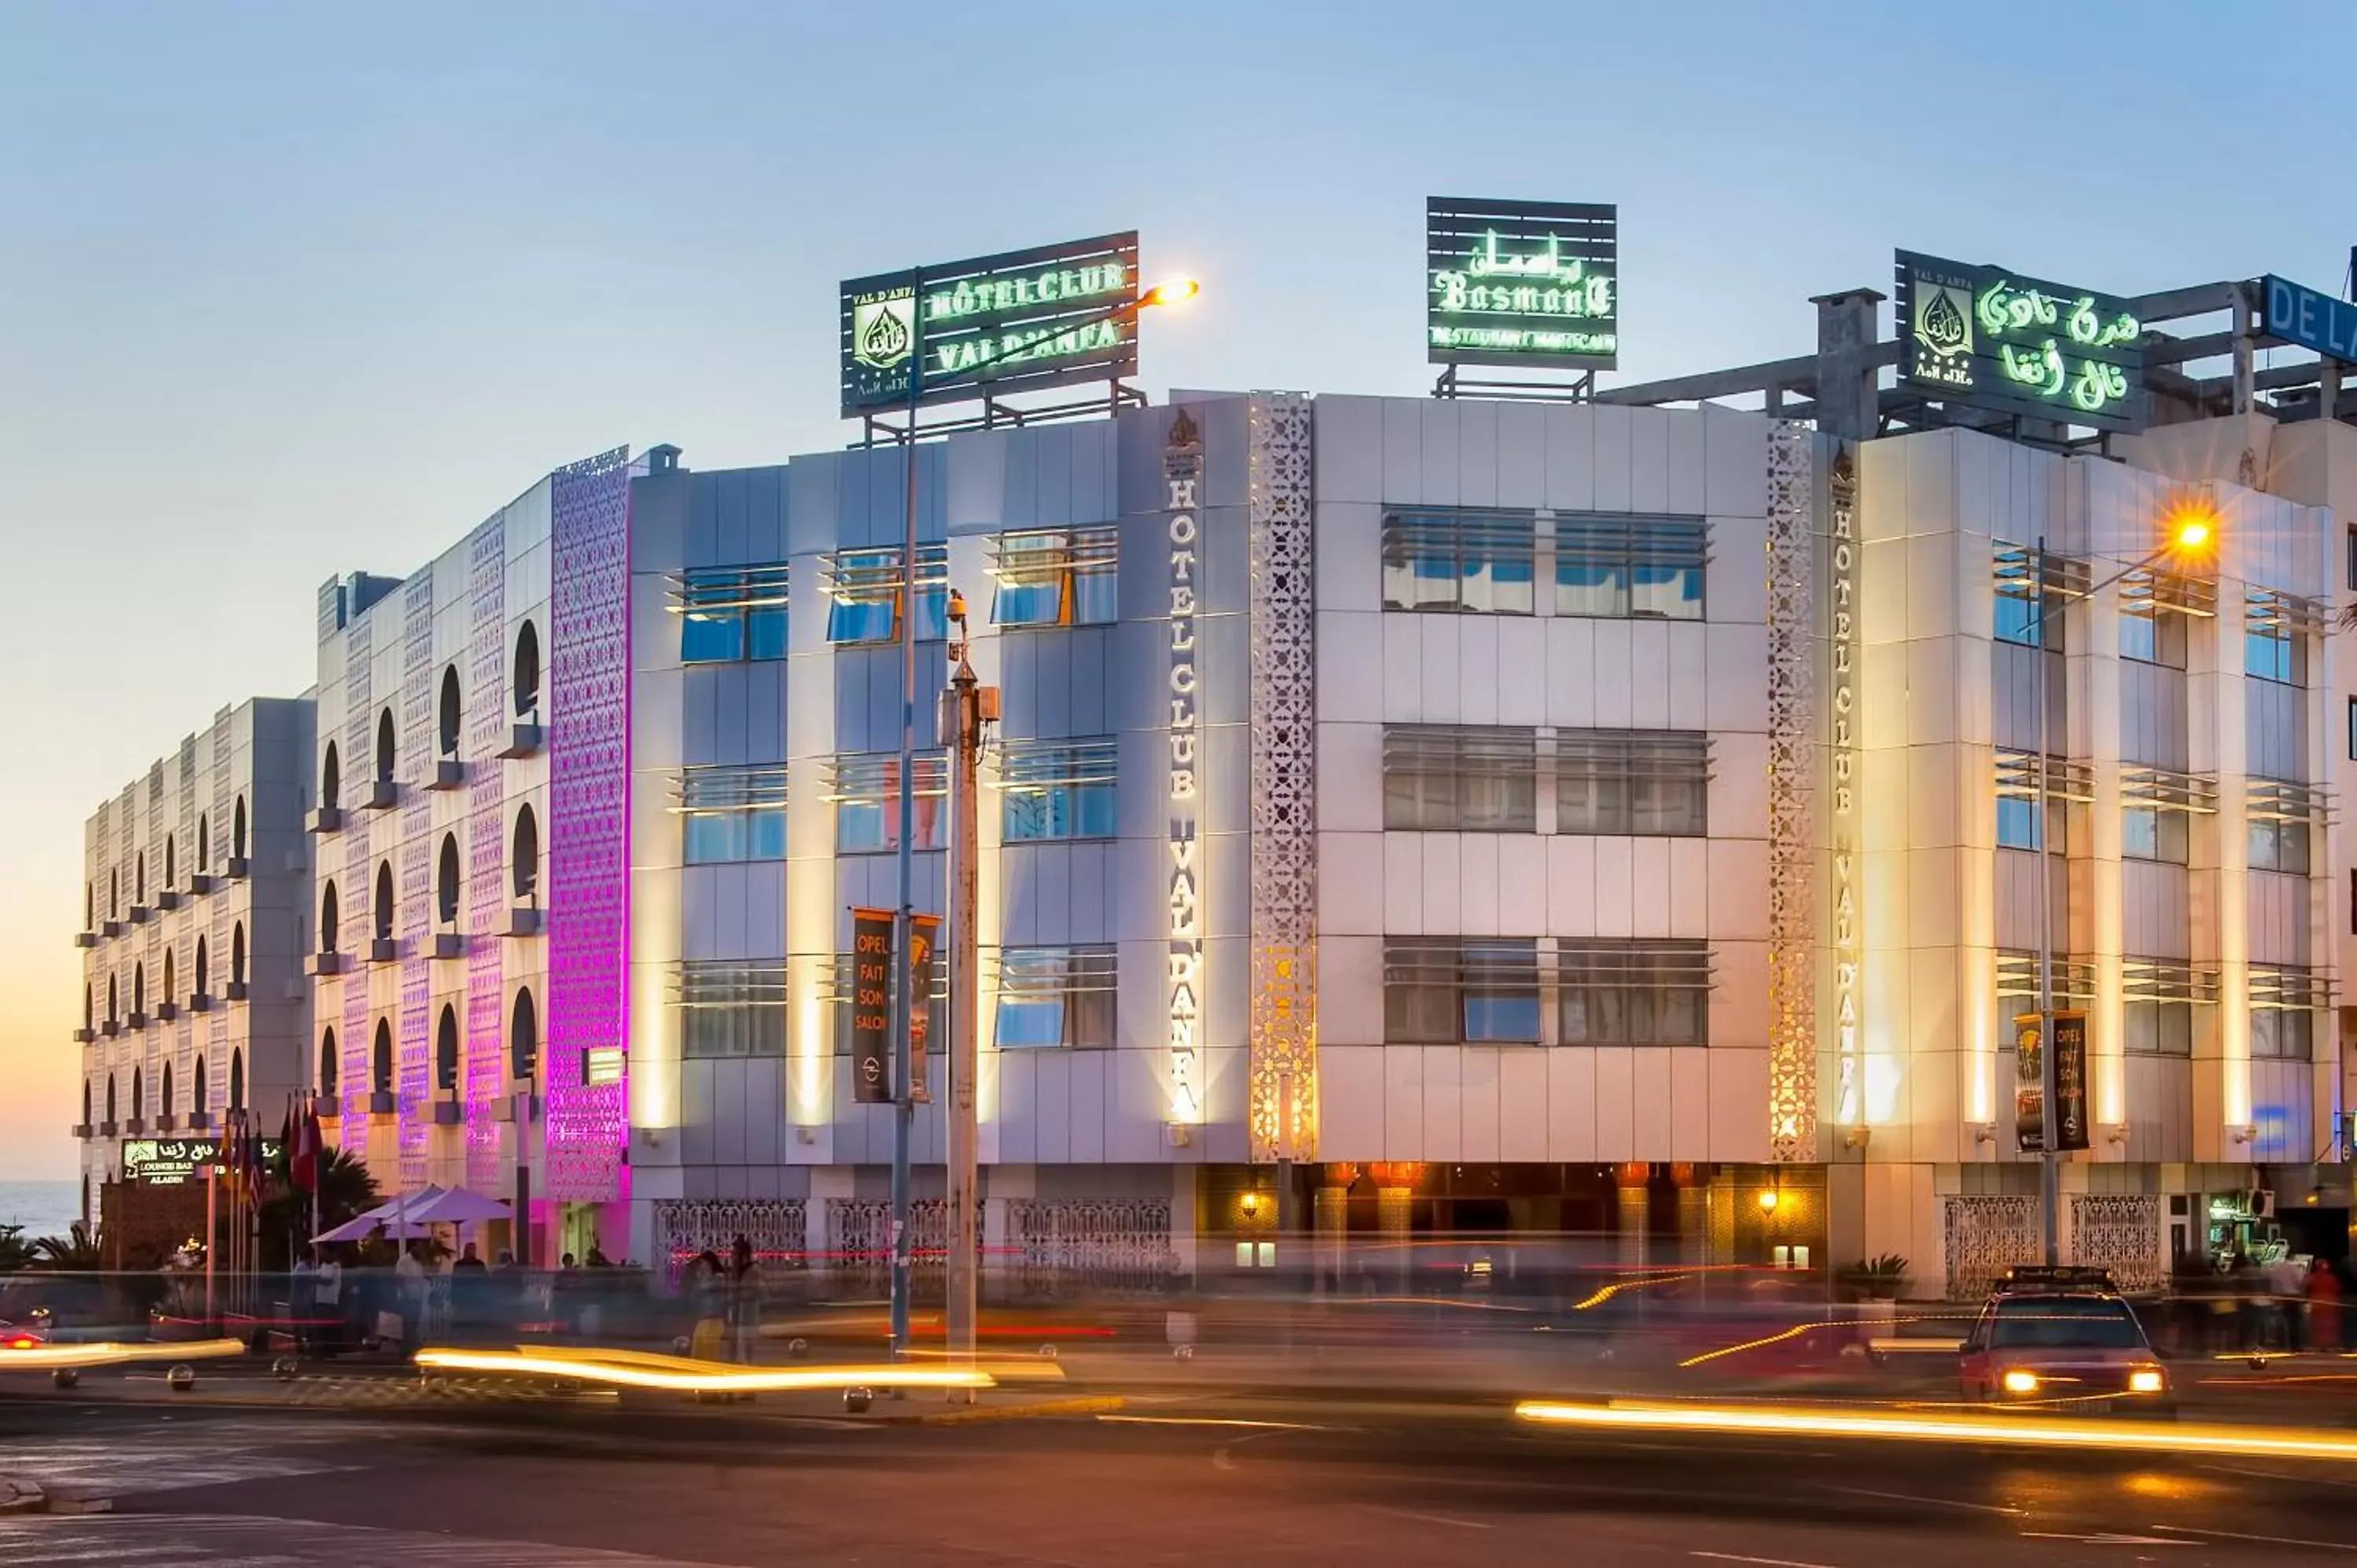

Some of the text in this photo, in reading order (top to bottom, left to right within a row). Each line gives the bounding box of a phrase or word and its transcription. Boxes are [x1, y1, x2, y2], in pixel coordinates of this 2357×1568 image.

[853, 292, 874, 306] VAL
[930, 263, 1124, 318] HÔTEL CLUB
[2271, 279, 2317, 342] DE
[1169, 479, 1197, 650] HOTEL
[1835, 509, 1853, 673] HOTEL
[1169, 664, 1197, 799] CLUB
[1835, 686, 1853, 815] CLUB
[1170, 840, 1196, 936] VAL
[1836, 855, 1854, 947] VAL
[856, 935, 889, 954] OPEL
[860, 963, 884, 982] FAIT
[859, 989, 884, 1006] SON
